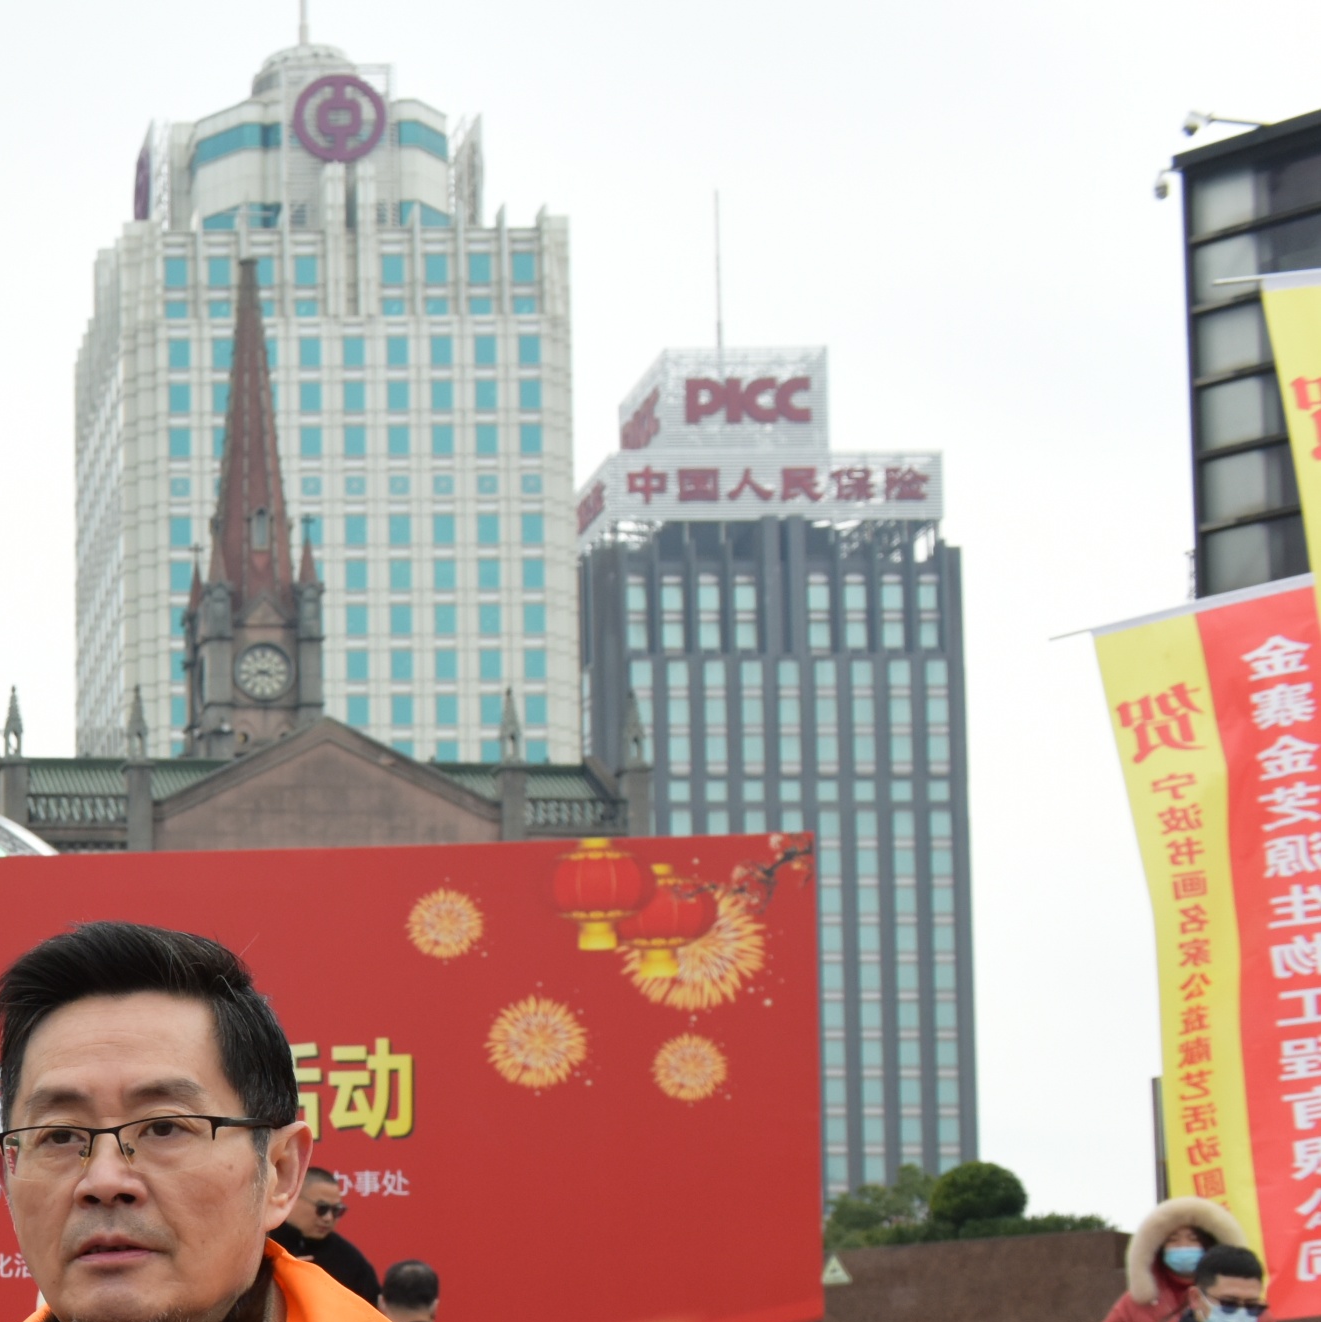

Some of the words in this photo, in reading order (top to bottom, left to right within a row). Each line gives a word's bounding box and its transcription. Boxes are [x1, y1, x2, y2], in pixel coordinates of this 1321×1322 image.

[685, 377, 812, 423] PICC
[627, 466, 930, 505] 中国人民保险
